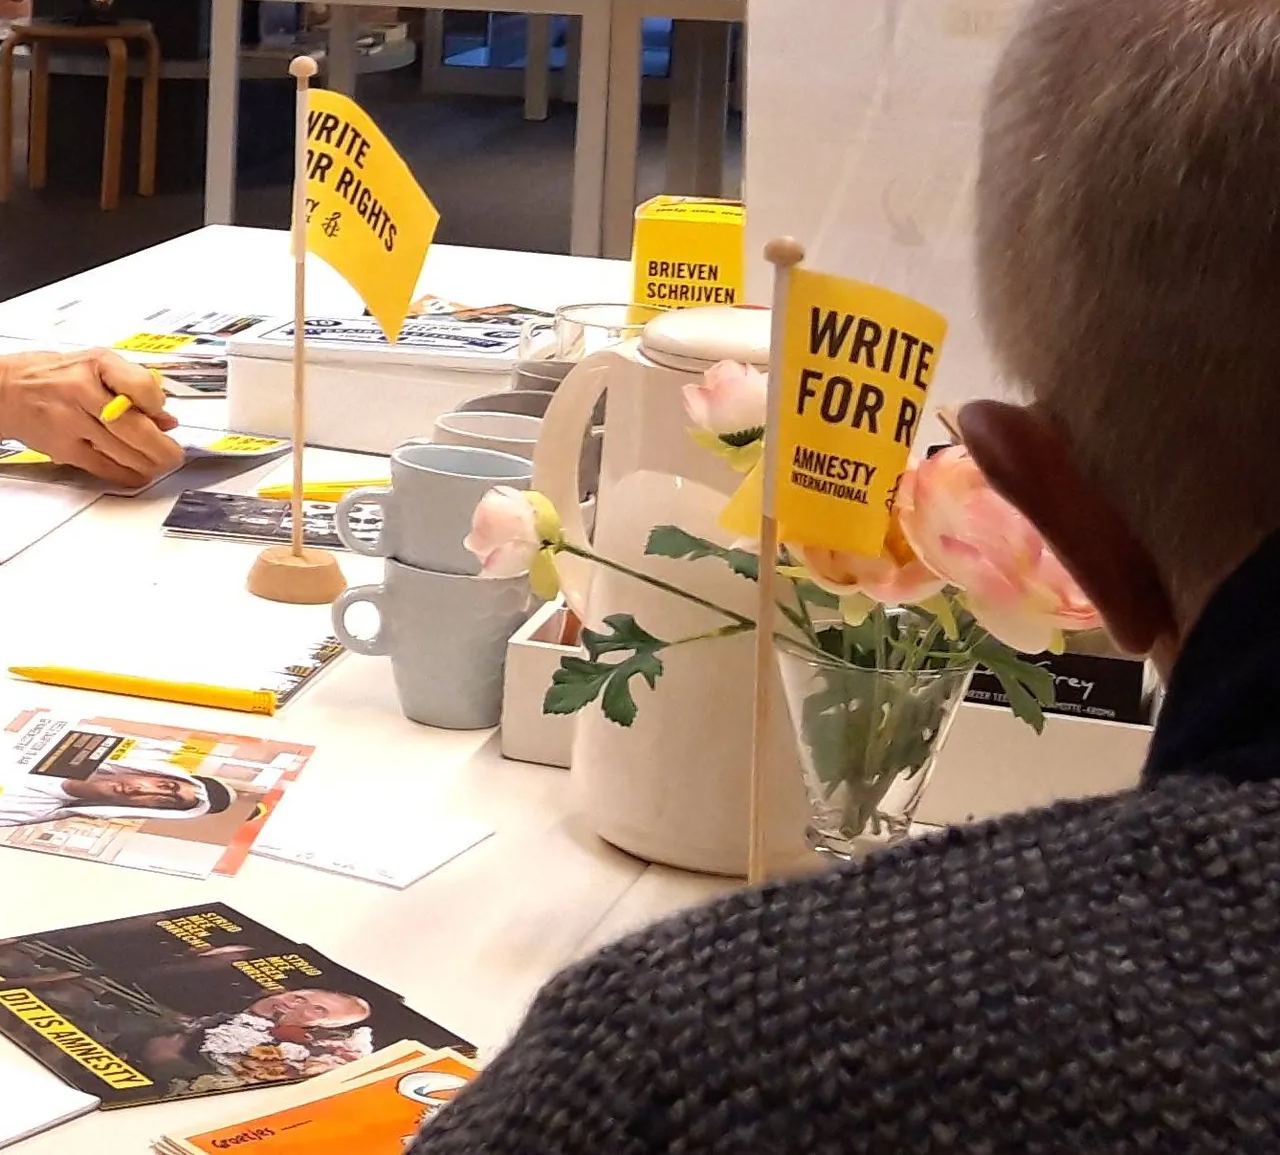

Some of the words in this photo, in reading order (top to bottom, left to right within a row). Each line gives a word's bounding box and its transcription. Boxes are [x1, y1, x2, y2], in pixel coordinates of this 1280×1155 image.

[334, 166, 398, 253] RIGHTS
[648, 260, 719, 281] BRIEVEN
[646, 282, 735, 304] SCHRIJVEN
[809, 306, 934, 392] WRITE
[796, 368, 885, 434] FOR
[894, 396, 922, 448] R
[793, 444, 877, 487] AMNESTY
[791, 471, 869, 505] INTERNATIONAL
[0, 992, 48, 1013] DIT
[32, 1014, 64, 1030] IS
[46, 1031, 145, 1085] AMNESTY
